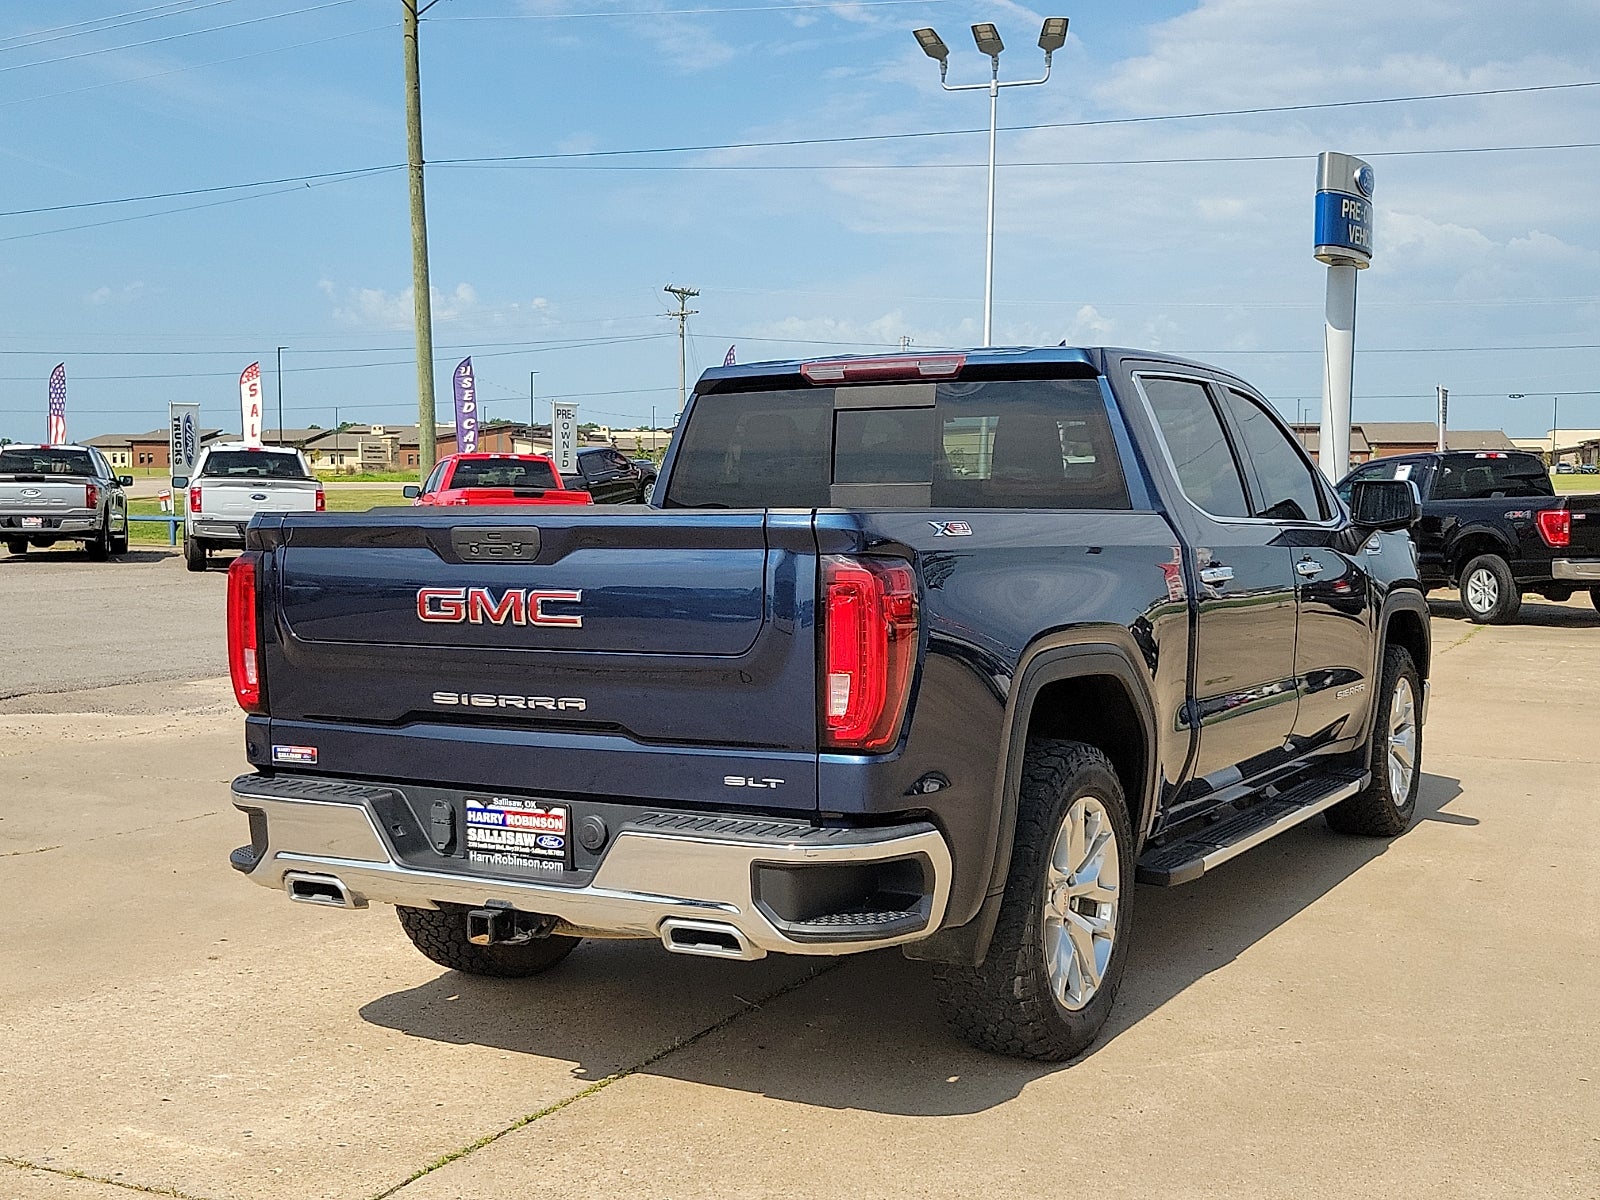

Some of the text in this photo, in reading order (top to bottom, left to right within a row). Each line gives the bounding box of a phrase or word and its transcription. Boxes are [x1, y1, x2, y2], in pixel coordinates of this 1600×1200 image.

[460, 365, 475, 413] USED
[173, 416, 183, 465] TRUCKS
[561, 422, 571, 467] OWNED
[416, 587, 582, 628] GMC
[432, 691, 587, 711] SIERRA
[723, 776, 785, 789] SLT
[493, 797, 537, 809] Sallisaw, OK
[467, 810, 563, 830] HARRY ROBINSON
[467, 827, 536, 847] SALLISAW
